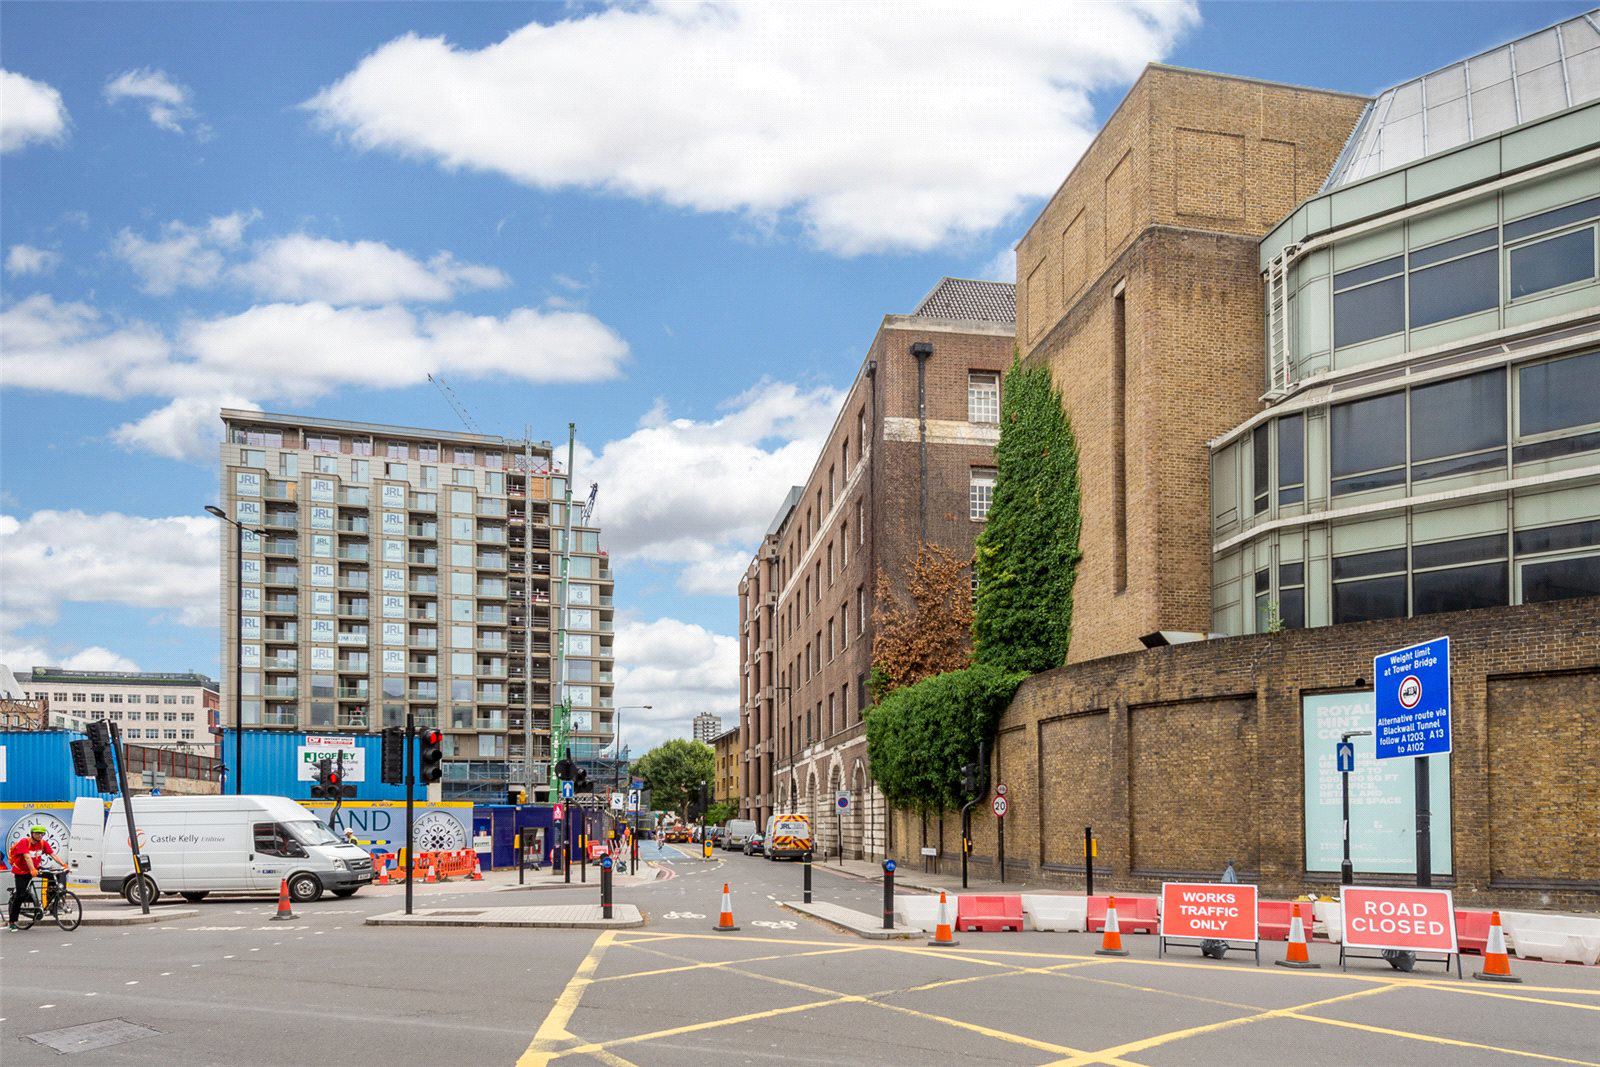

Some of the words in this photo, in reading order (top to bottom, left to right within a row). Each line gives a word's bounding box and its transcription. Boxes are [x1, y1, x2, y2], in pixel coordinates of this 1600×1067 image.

[238, 474, 259, 486] JRL
[312, 479, 332, 491] JRL
[384, 487, 403, 497] JRL
[238, 502, 259, 514] JRL
[312, 508, 332, 520] JRL
[384, 514, 403, 524] JRL
[316, 538, 329, 546] JRL
[312, 565, 332, 576] JRL
[384, 570, 403, 580] JRL
[384, 598, 403, 608] JRL
[312, 622, 332, 632] JRL
[384, 624, 403, 635] JRL
[312, 648, 332, 659] JRL
[384, 652, 403, 662] JRL
[1390, 652, 1412, 664] Weight
[1414, 646, 1430, 658] limit
[1384, 668, 1391, 676] at
[1392, 662, 1412, 674] Tower
[1414, 657, 1437, 669] Bridge
[1317, 703, 1376, 717] ROYAL
[1317, 715, 1360, 728] MINT
[1378, 713, 1413, 726] Alternative
[1415, 710, 1434, 720] route
[1436, 708, 1446, 716] via
[1384, 724, 1415, 735] Blackwall
[1417, 719, 1440, 730] Tunnel
[1380, 737, 1399, 746] follow
[1430, 729, 1444, 738] A13
[1407, 743, 1424, 752] A102
[995, 802, 1005, 810] 20
[50, 821, 69, 848] MINT
[447, 819, 463, 842] MINT
[150, 834, 176, 843] Castle
[179, 834, 199, 844] Kelly
[1183, 892, 1236, 903] WORKS
[1179, 905, 1239, 917] TRAFFIC
[1364, 901, 1428, 916] ROAD
[1189, 919, 1228, 930] ONLY
[1352, 918, 1444, 935] CLOSED
